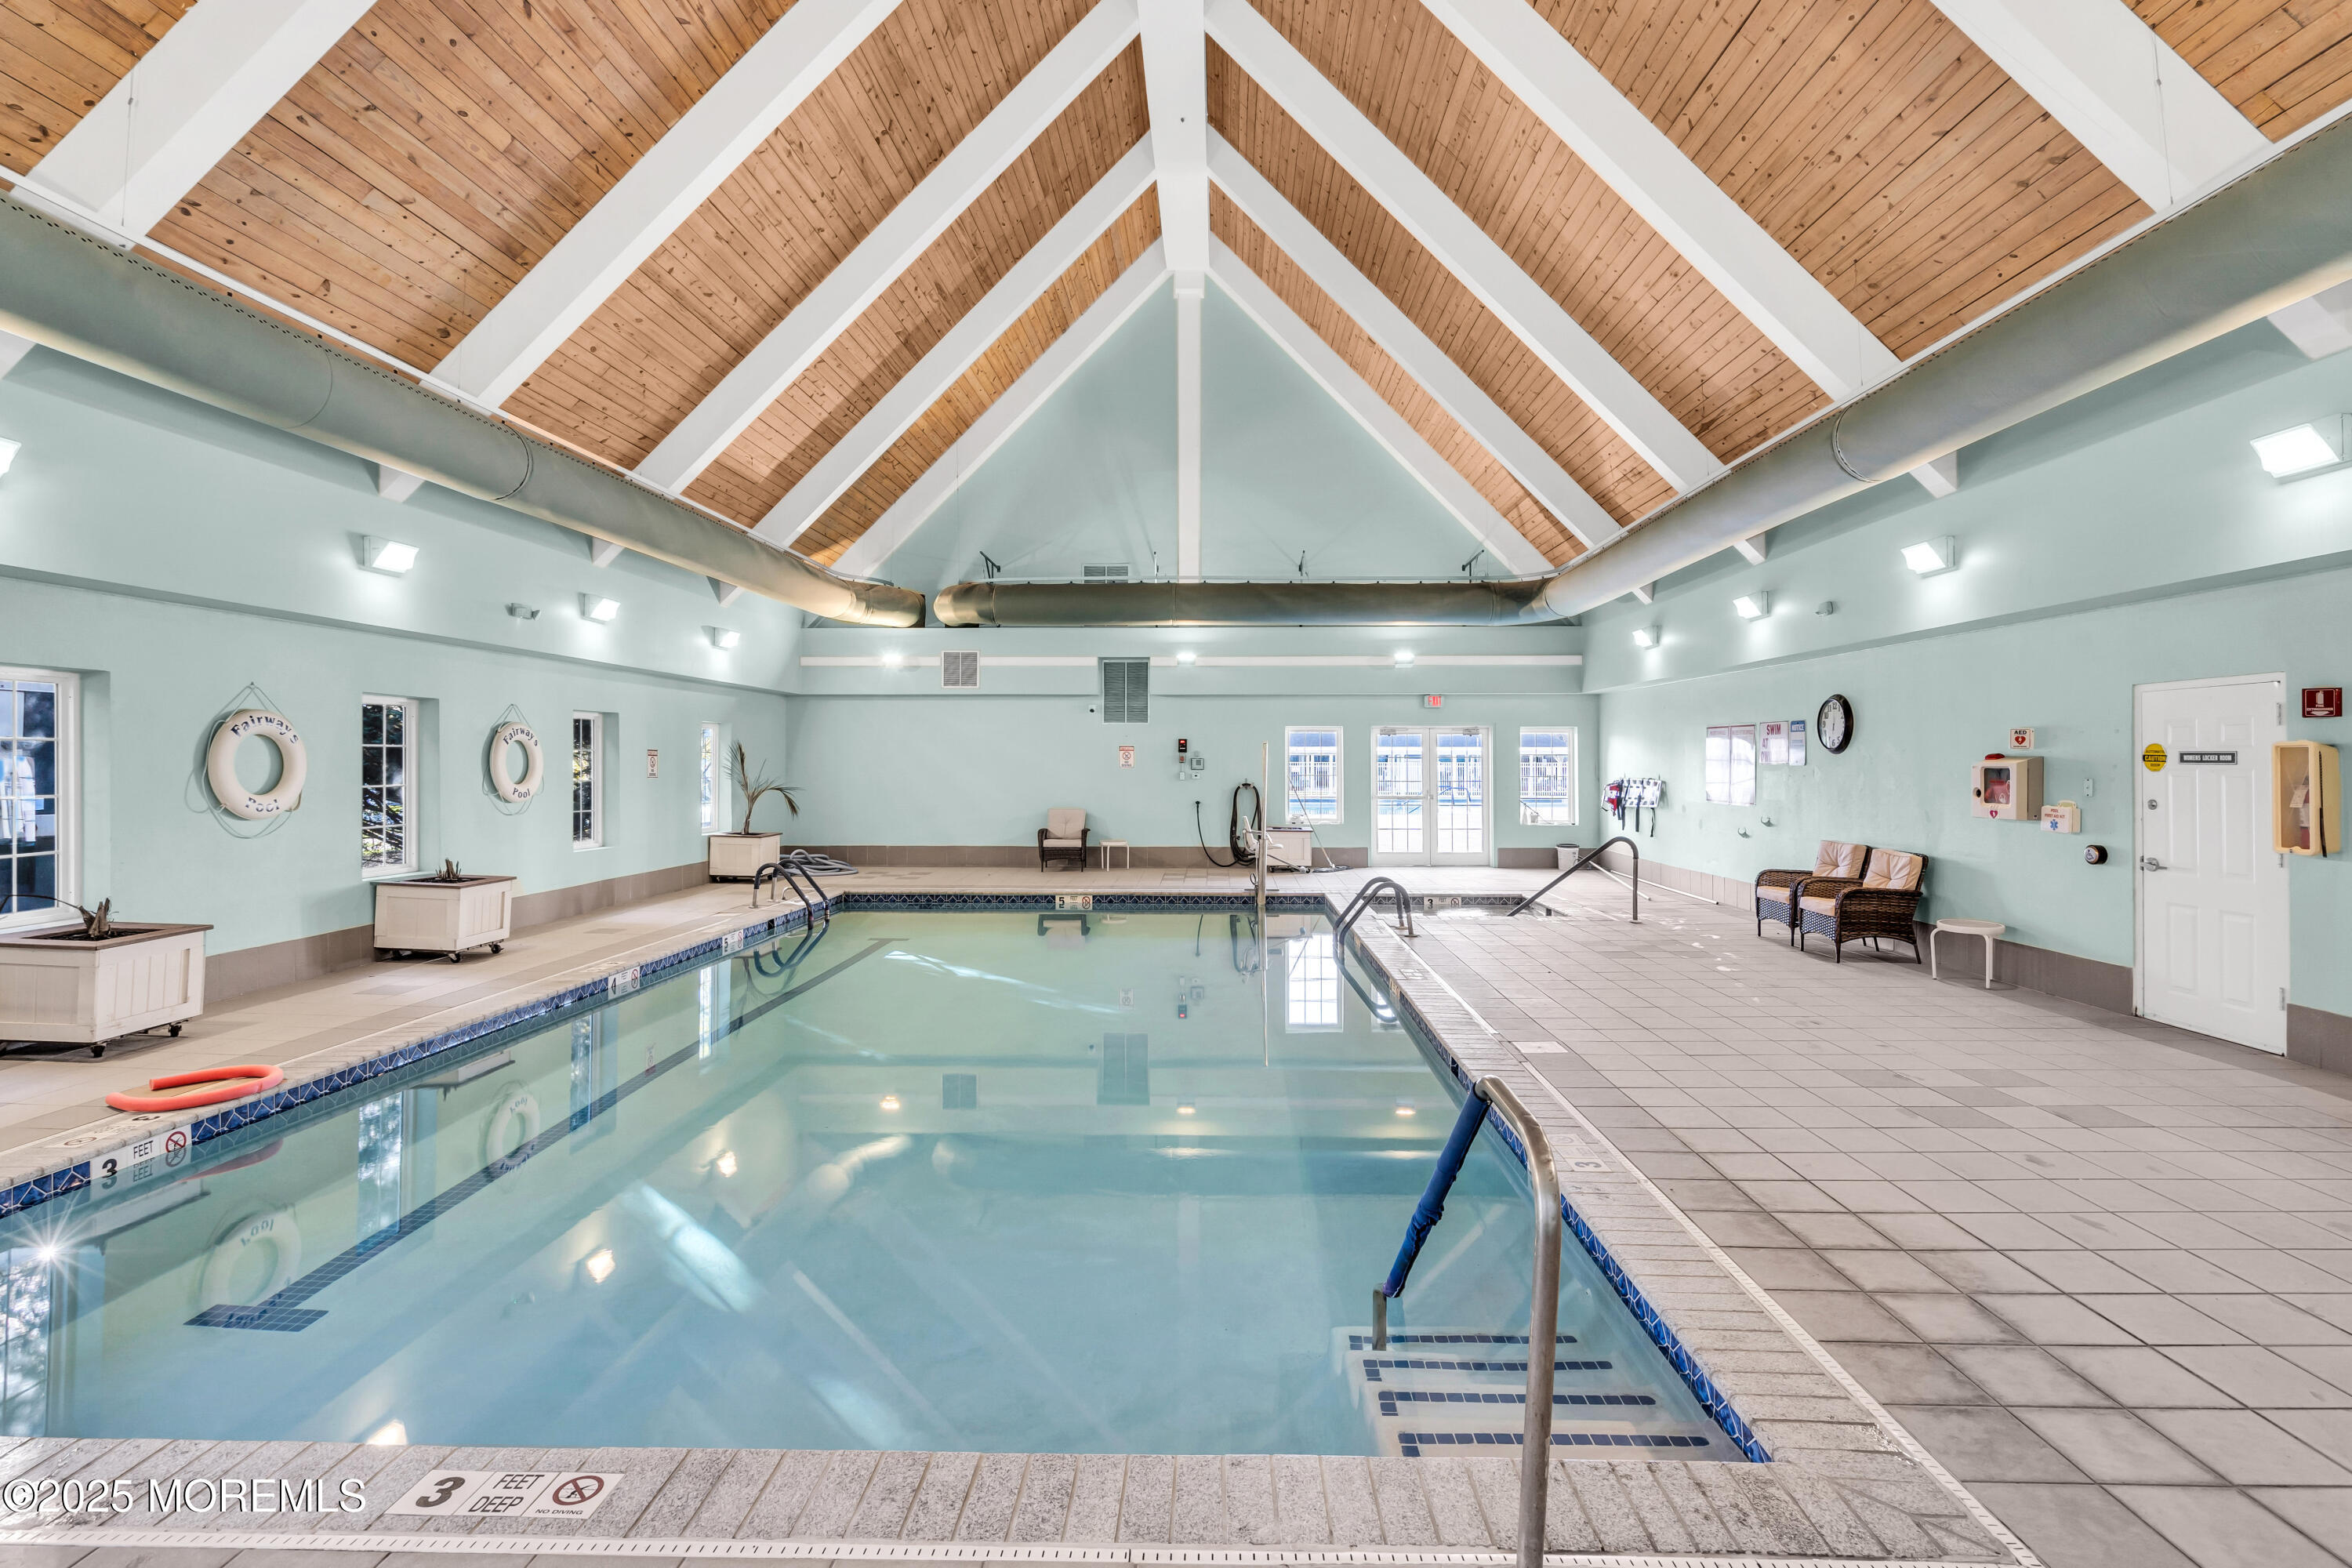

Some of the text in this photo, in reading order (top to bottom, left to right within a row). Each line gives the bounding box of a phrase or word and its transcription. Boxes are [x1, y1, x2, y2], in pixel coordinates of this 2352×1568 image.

[1428, 695, 1441, 706] EXIT
[230, 715, 299, 744] Fairways
[503, 728, 538, 746] Fairways
[1766, 724, 1781, 735] SWIM
[1762, 739, 1769, 749] AT
[512, 787, 530, 798] Pool
[245, 797, 280, 812] Pool
[133, 1141, 154, 1160] FEET
[102, 1159, 118, 1178] 3
[493, 1474, 545, 1490] FEET
[416, 1477, 466, 1508] 3
[468, 1496, 524, 1512] DEEP
